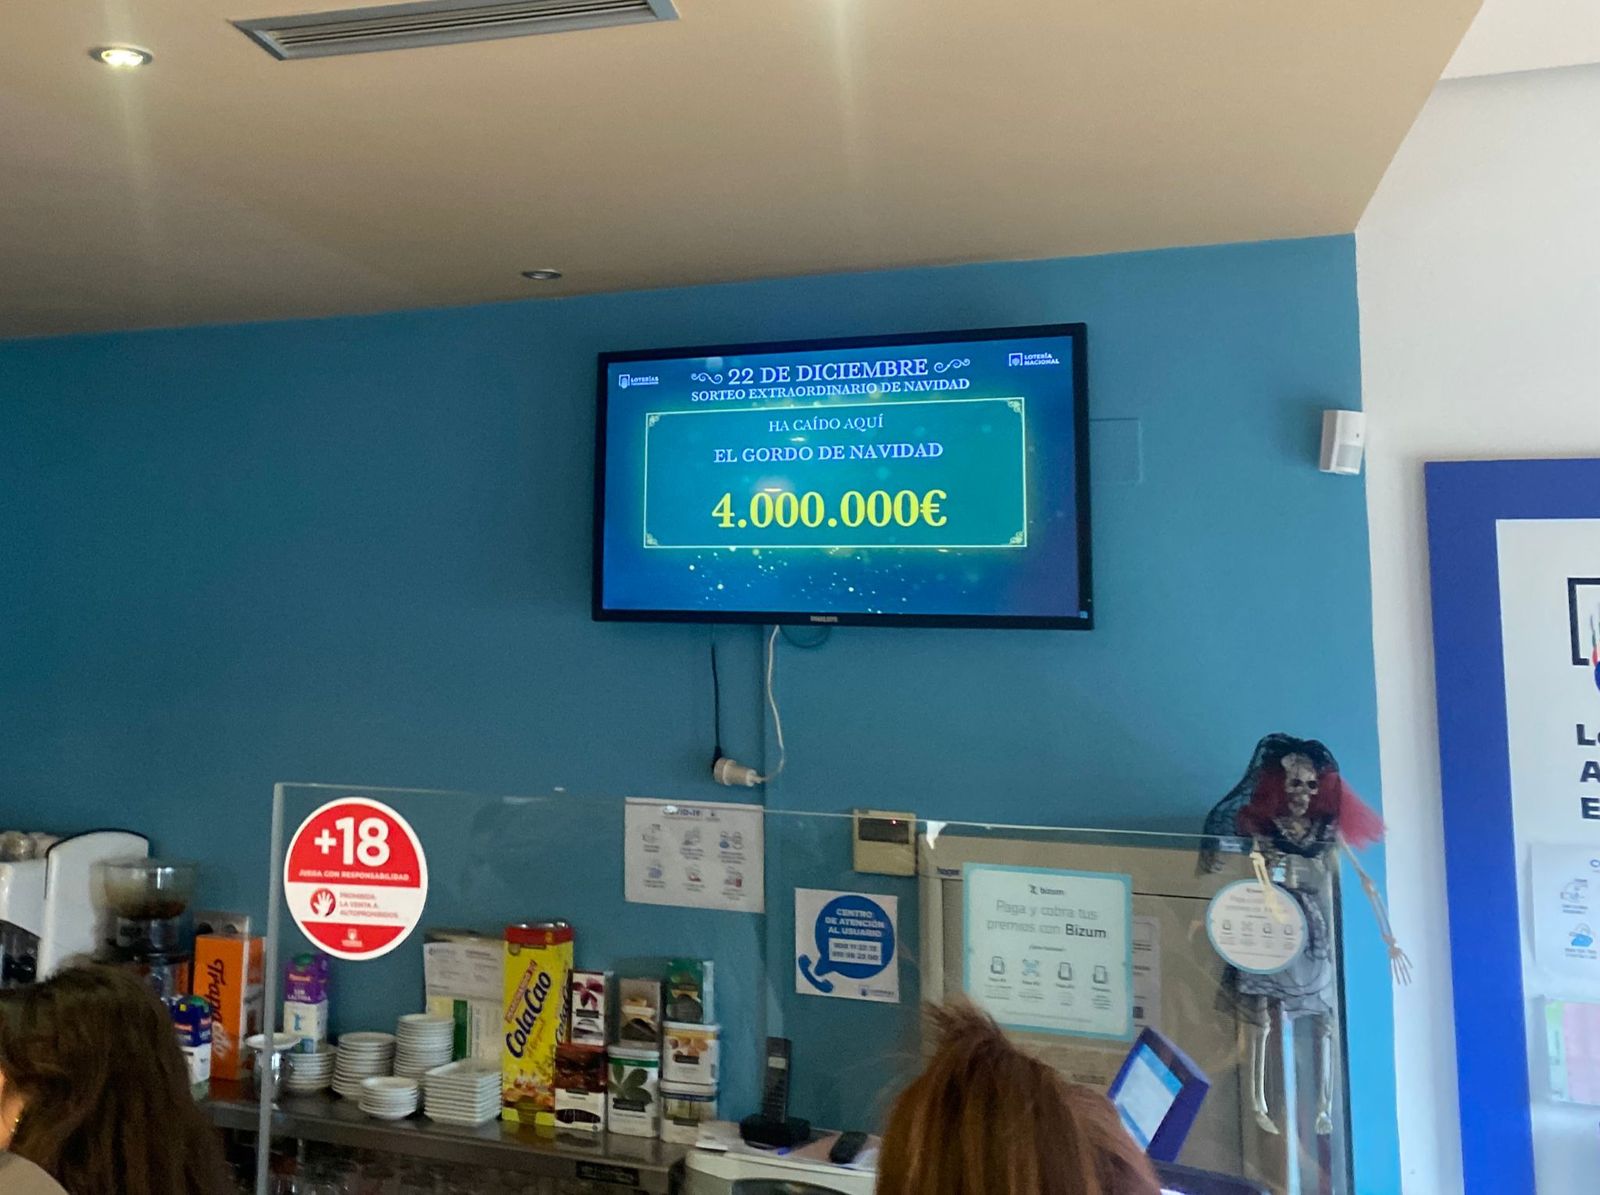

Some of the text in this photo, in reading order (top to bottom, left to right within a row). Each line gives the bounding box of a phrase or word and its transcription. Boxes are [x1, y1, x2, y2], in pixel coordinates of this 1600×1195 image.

[1024, 352, 1052, 360] LOTERÍA
[728, 358, 928, 385] 22 DE DICIEMBRE
[691, 378, 970, 402] SORTEO EXTRAORDINARIO DE NAVIDAD
[769, 413, 884, 432] HA CAÍDO AQUÍ
[714, 442, 943, 463] EL GORDO DE NAVIDAD
[711, 489, 948, 528] 4.000.000€
[1576, 724, 1600, 746] L
[314, 816, 391, 867] +18
[324, 870, 340, 878] CON
[341, 870, 410, 881] RESPONSABILIDAD
[836, 909, 872, 918] CENTRO
[996, 899, 1098, 920] Paga y cobra tus
[825, 917, 837, 925] DE
[1065, 923, 1106, 938] Bizum
